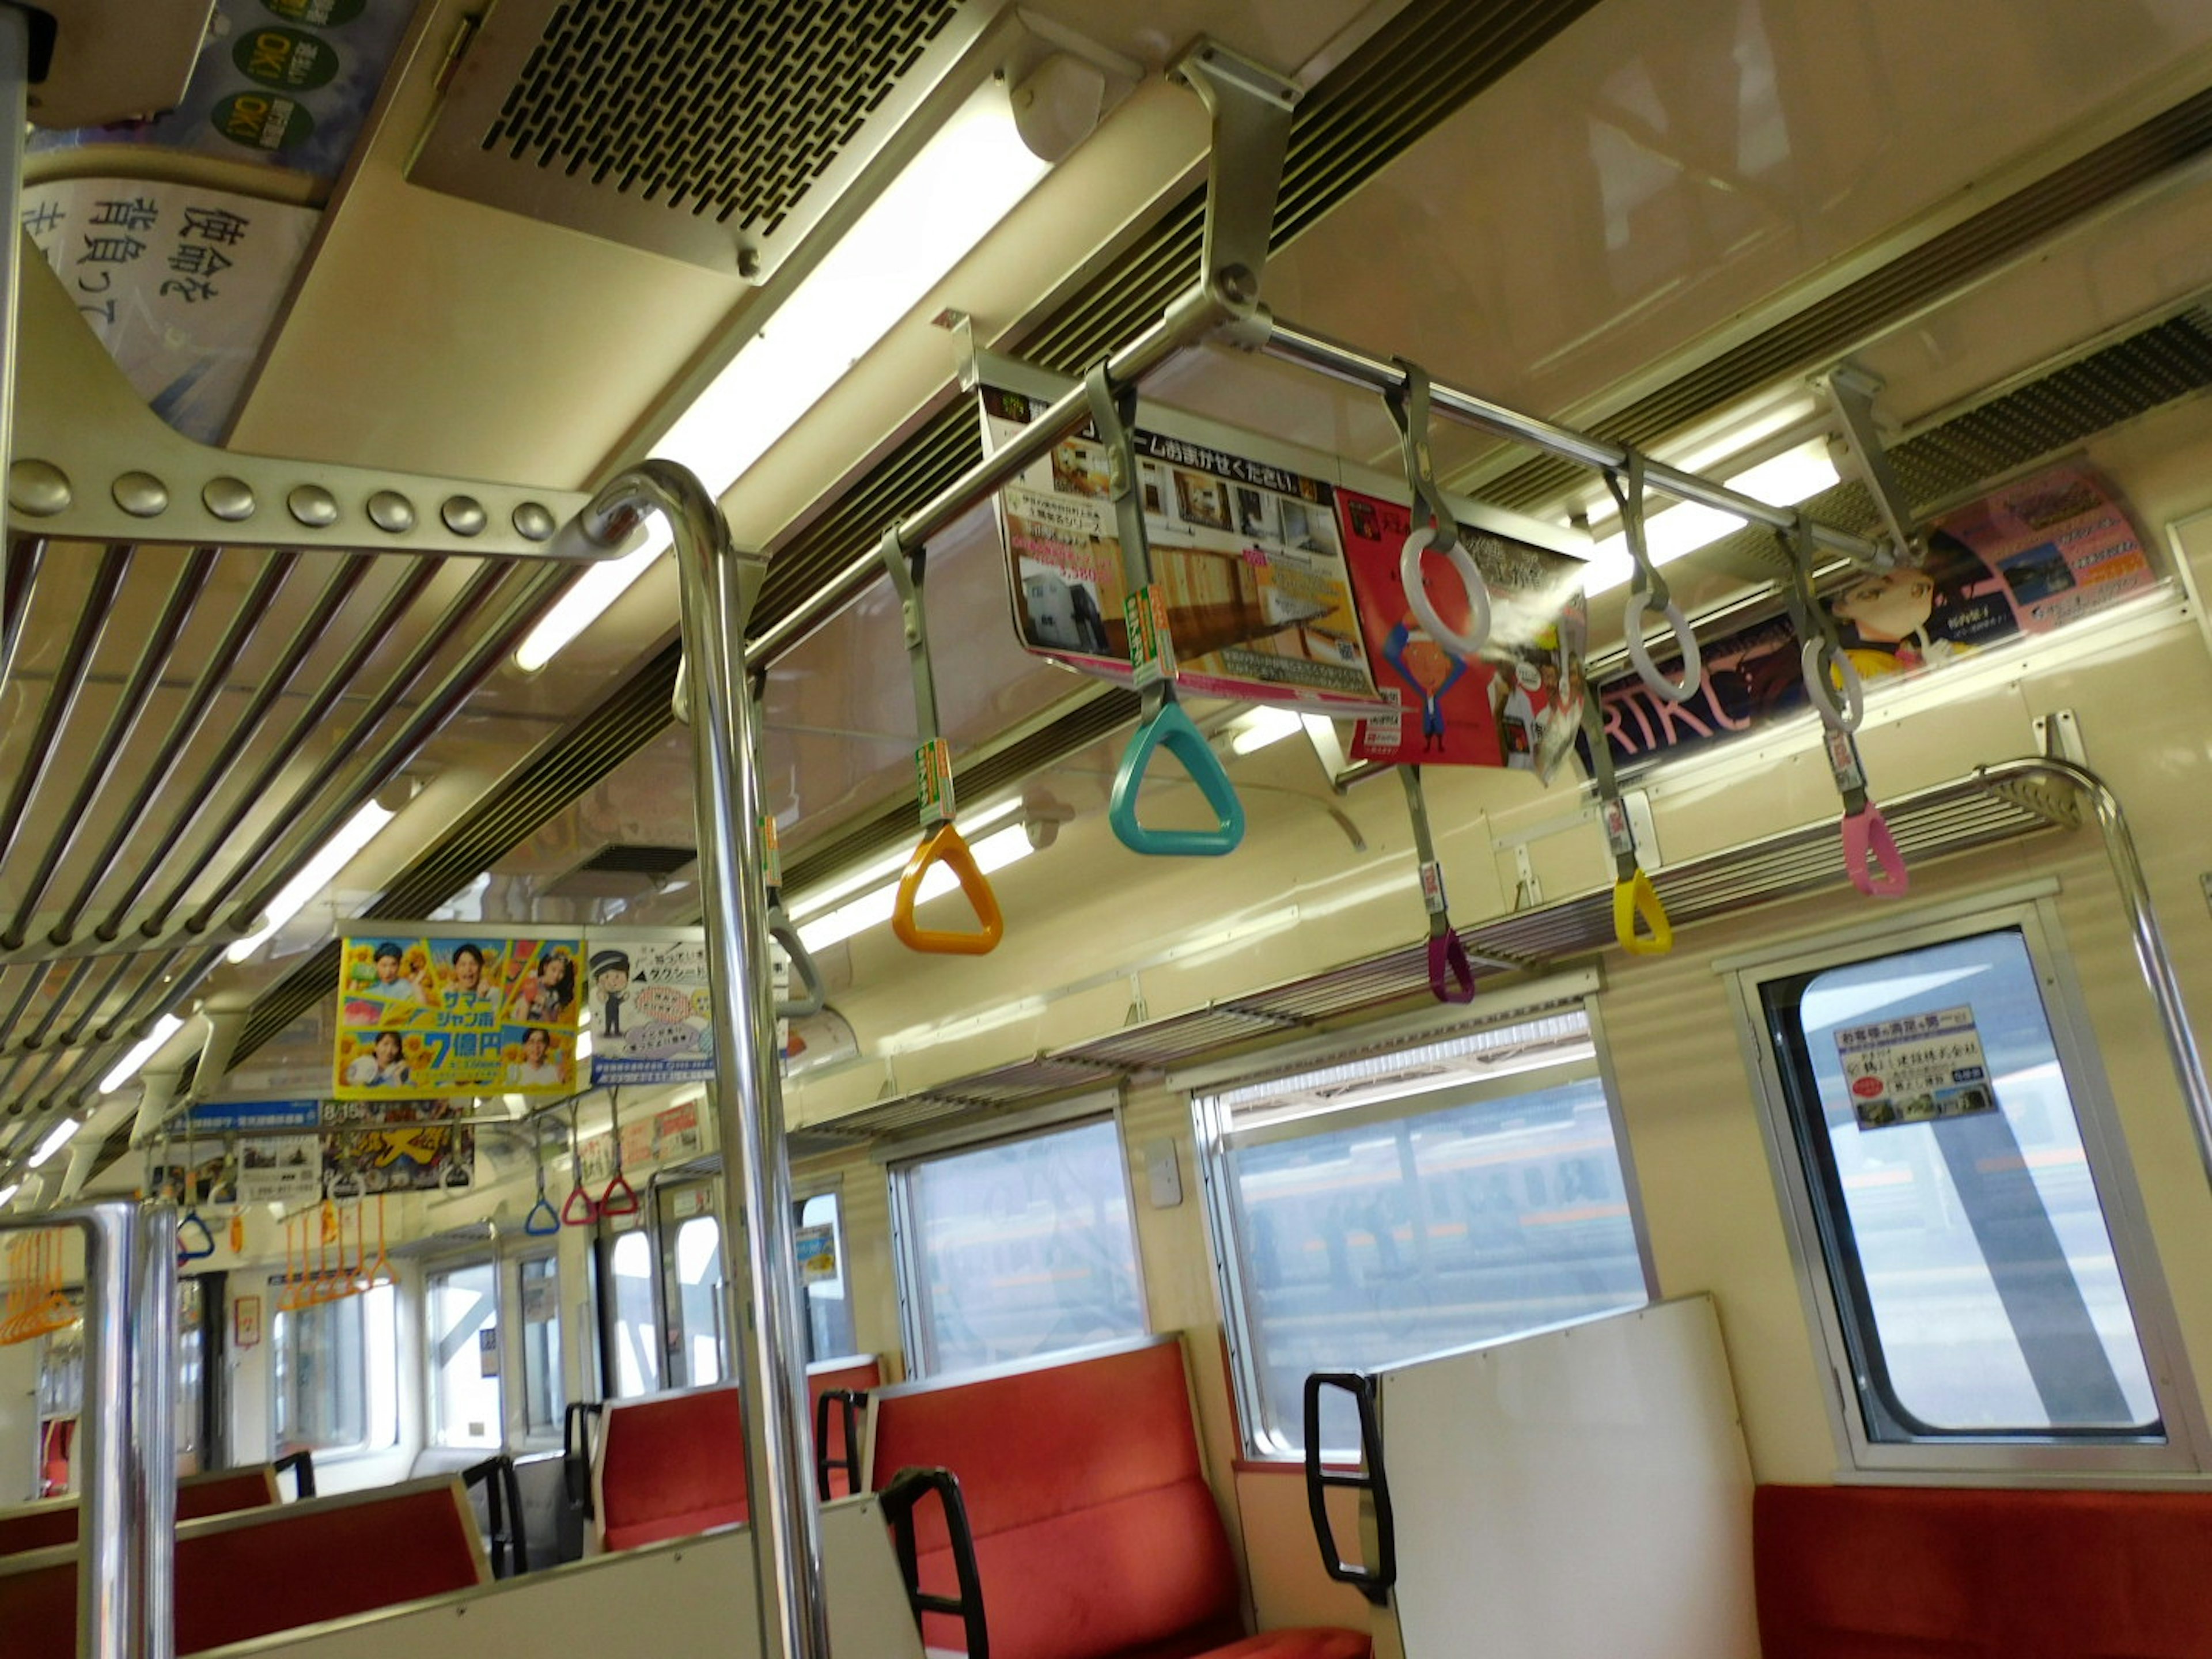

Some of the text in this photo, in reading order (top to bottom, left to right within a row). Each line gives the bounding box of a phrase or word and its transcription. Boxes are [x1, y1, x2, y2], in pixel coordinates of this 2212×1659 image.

[77, 196, 159, 325] 背負って
[160, 204, 250, 305] 使命を
[443, 992, 491, 1008] サマー
[424, 1032, 503, 1070] 7億円
